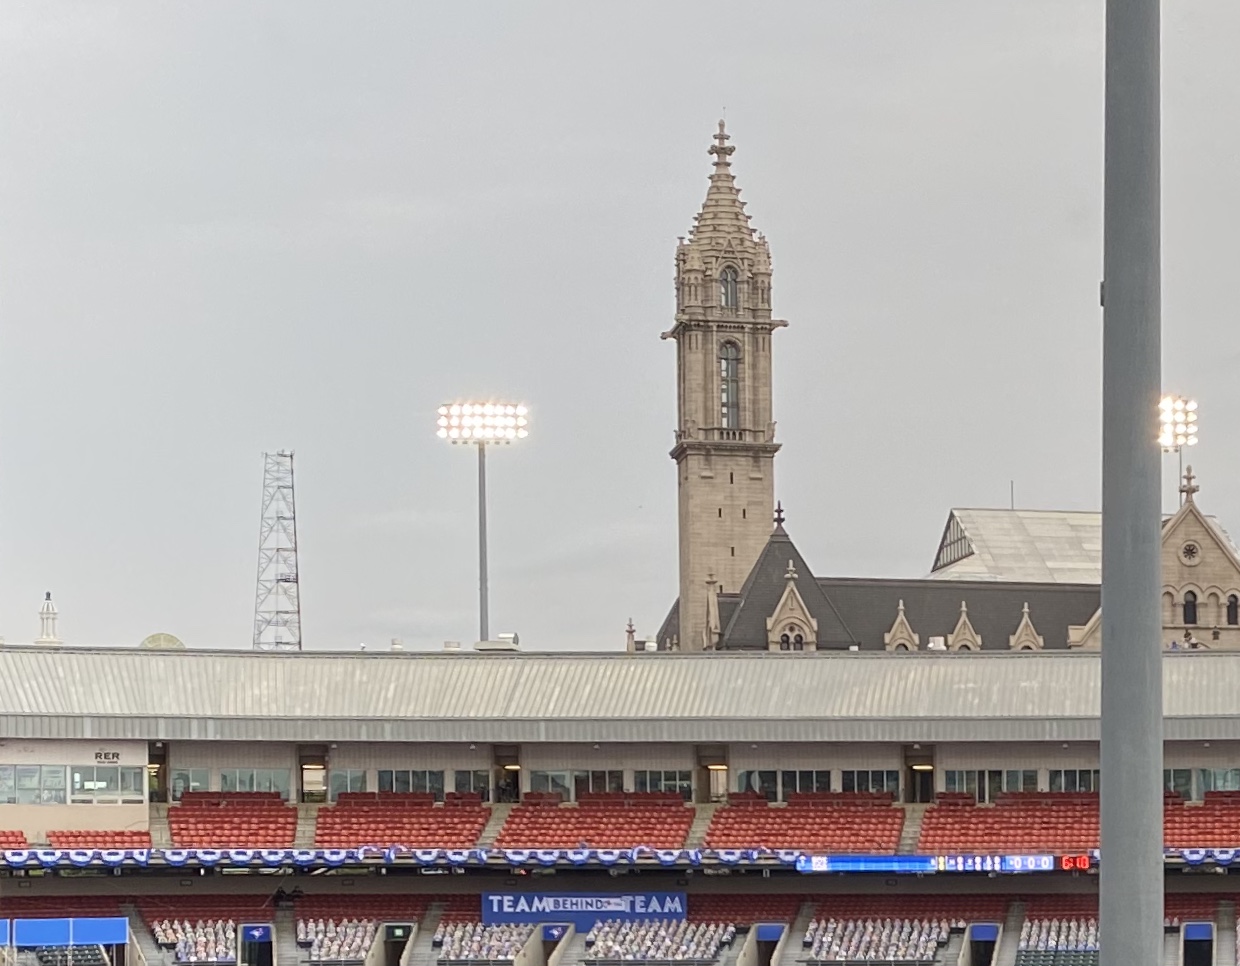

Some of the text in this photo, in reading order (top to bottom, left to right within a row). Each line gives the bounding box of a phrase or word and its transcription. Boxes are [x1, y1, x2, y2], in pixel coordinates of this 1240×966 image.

[94, 752, 120, 760] RER
[488, 895, 551, 912] TEAM
[553, 898, 602, 910] BEHIND
[621, 896, 682, 913] TEAM
